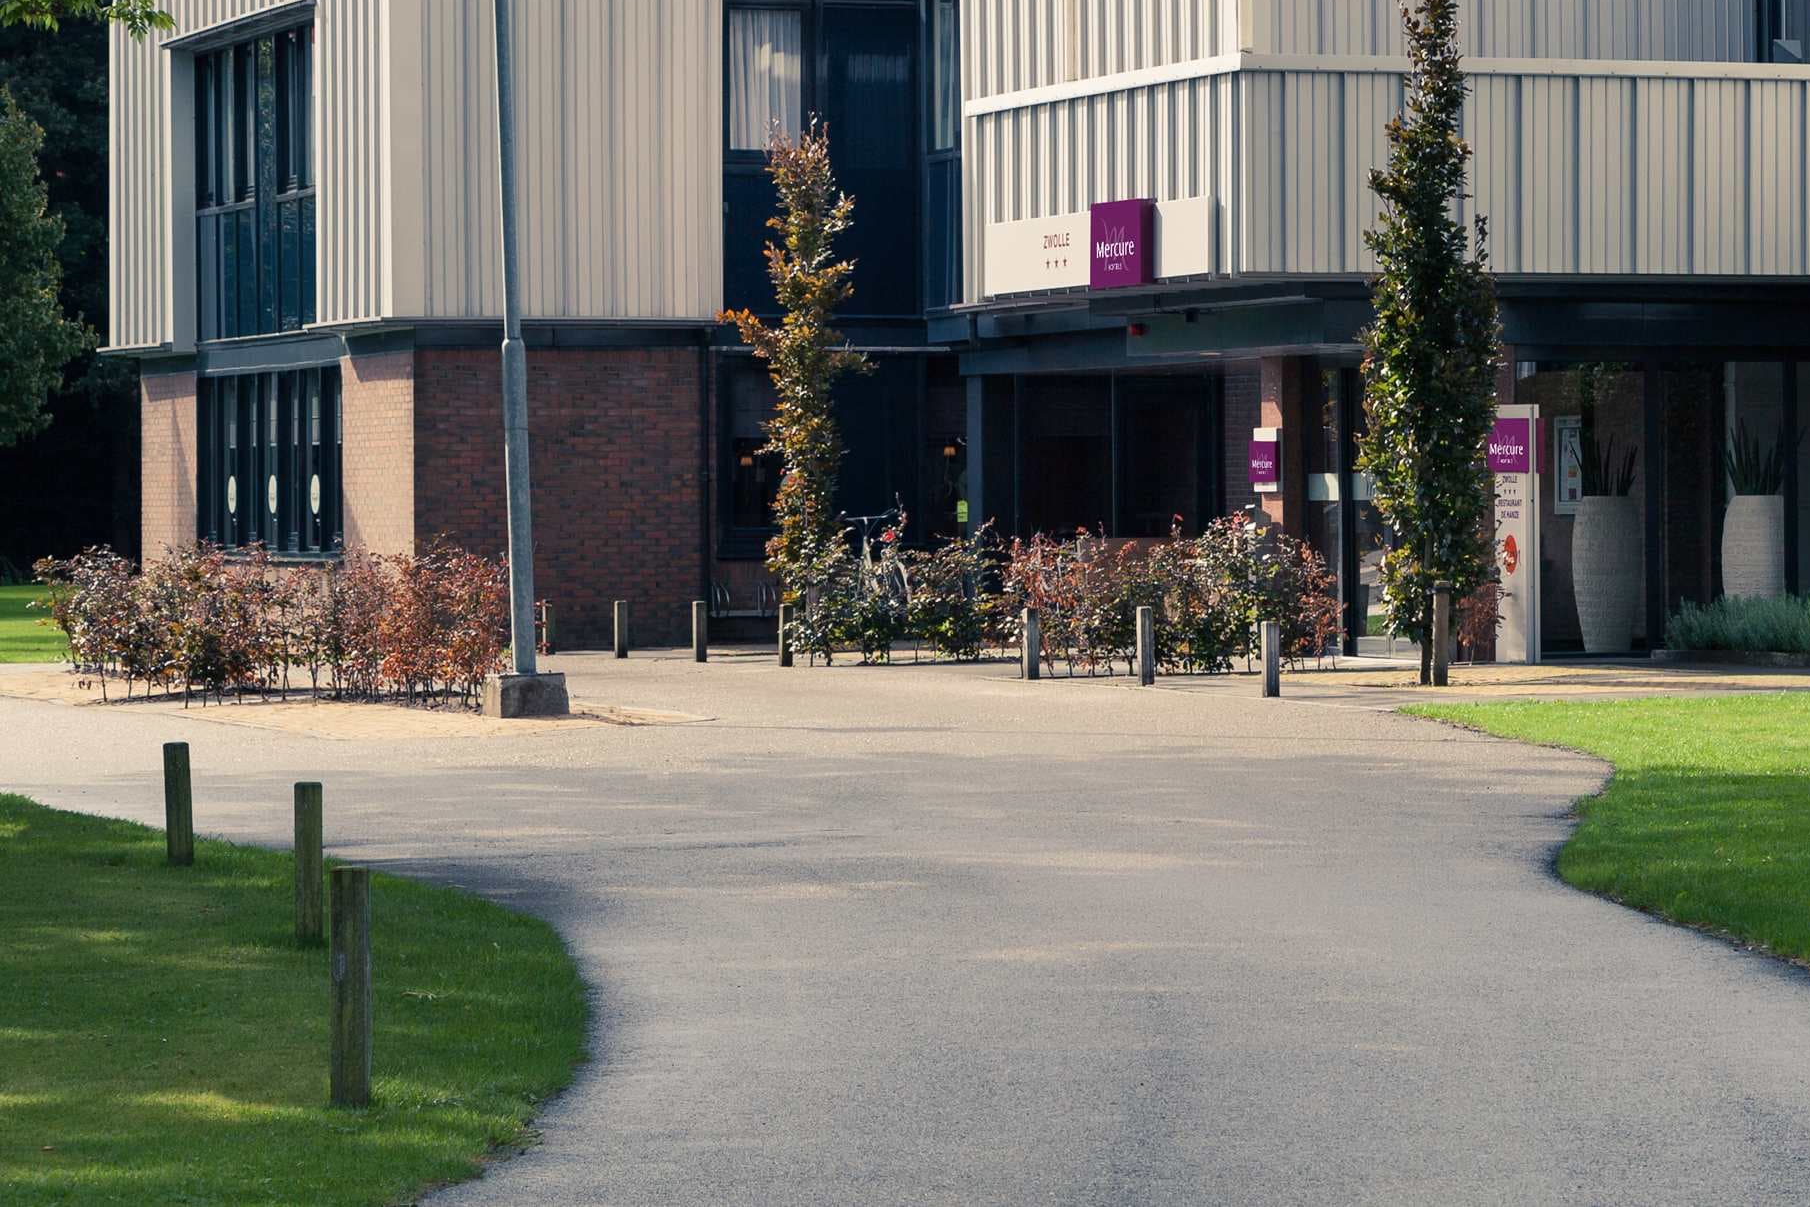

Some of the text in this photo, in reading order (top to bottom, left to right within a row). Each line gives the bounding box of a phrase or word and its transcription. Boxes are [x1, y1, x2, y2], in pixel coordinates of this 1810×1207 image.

[1043, 232, 1070, 249] ZWOLLE
[1096, 240, 1135, 259] Mercure
[1489, 443, 1524, 456] Mercure
[1251, 459, 1273, 469] Mercure
